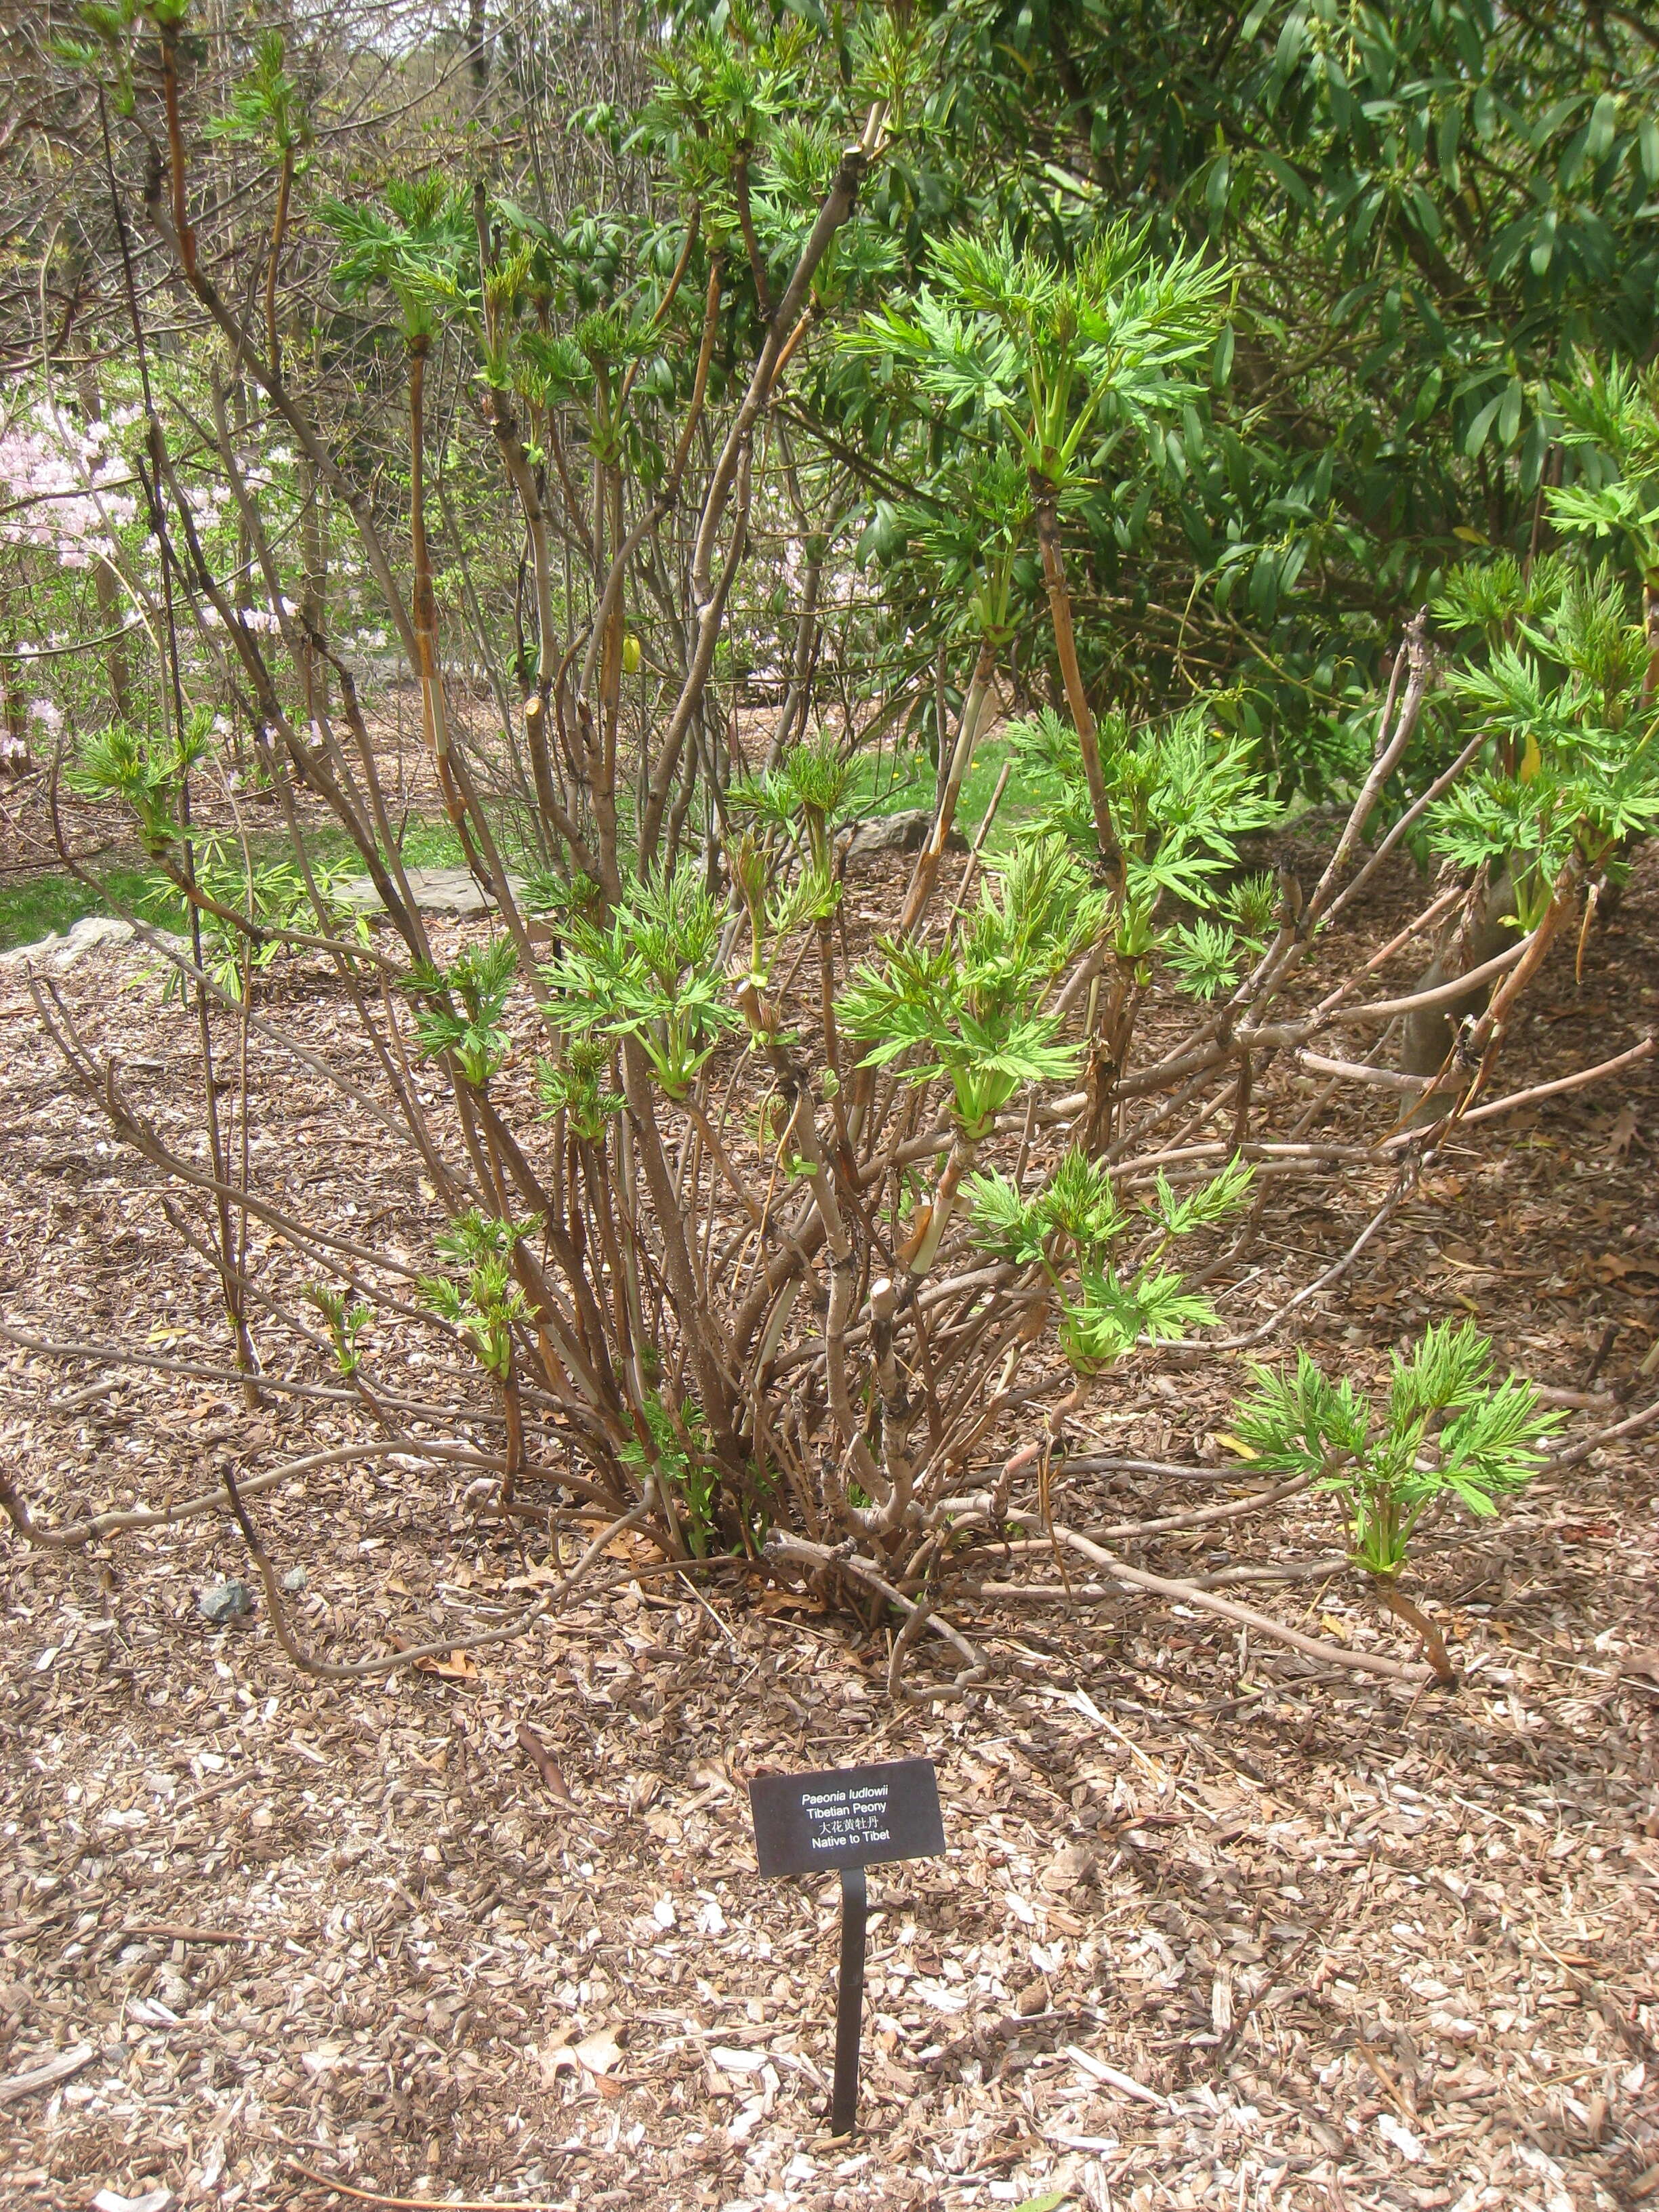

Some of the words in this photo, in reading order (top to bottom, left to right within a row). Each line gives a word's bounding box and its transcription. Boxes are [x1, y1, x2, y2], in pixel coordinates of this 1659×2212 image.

[802, 1790, 846, 1805] Paeonia
[849, 1784, 888, 1800] ludlowii
[806, 1805, 850, 1820] Tibetian
[853, 1801, 886, 1814] Peony
[819, 1816, 878, 1835] 大花黄牡丹
[812, 1833, 846, 1849] Native
[849, 1833, 860, 1844] to
[863, 1830, 890, 1843] Tibet
